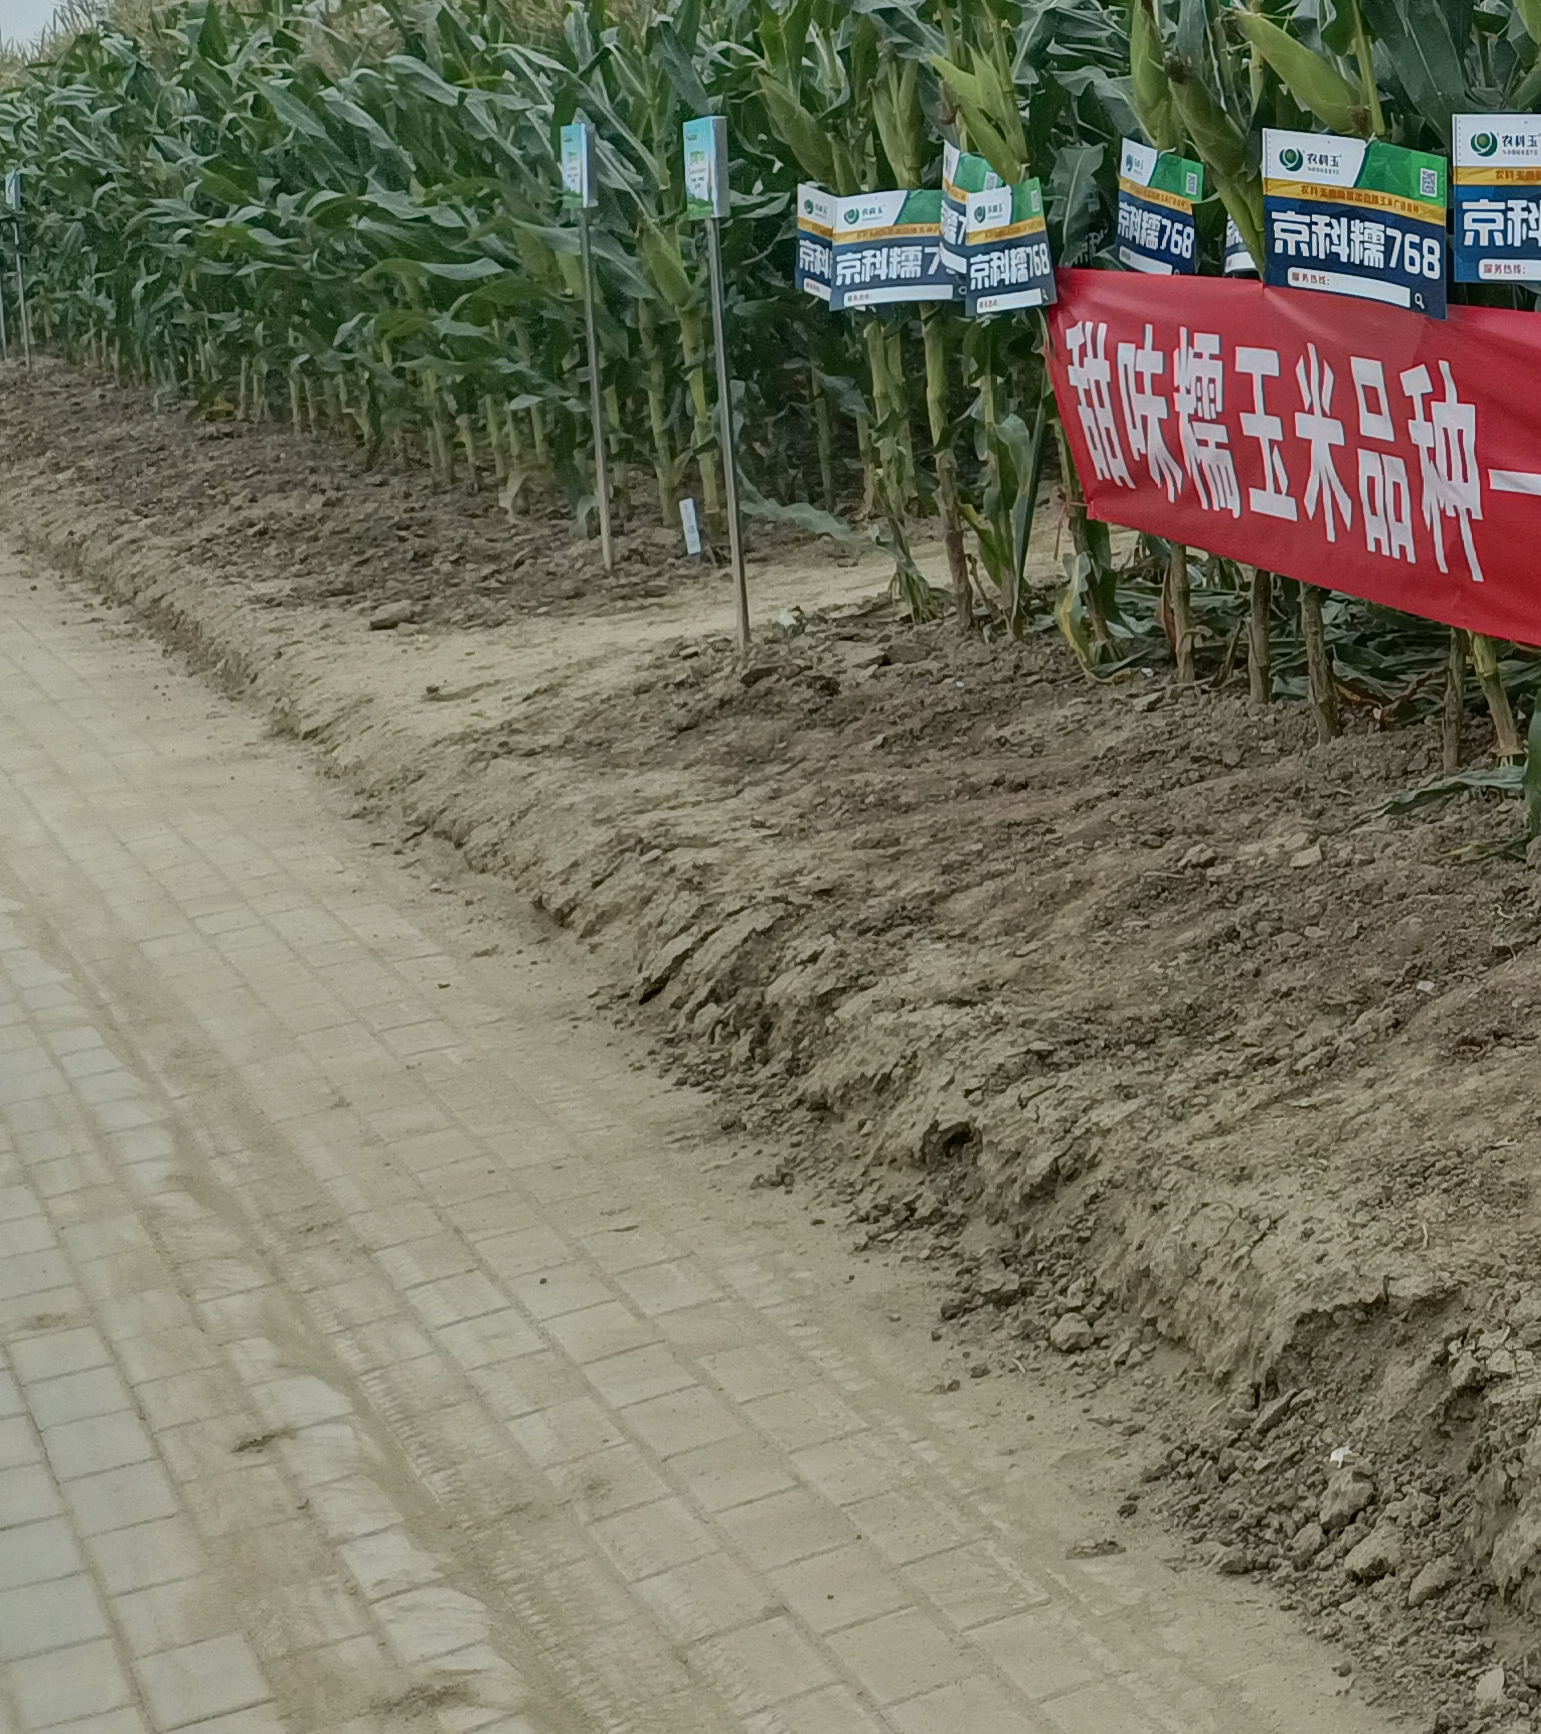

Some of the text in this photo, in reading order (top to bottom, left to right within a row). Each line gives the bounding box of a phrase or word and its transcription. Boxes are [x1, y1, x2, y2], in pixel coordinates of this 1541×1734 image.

[1118, 201, 1196, 259] 京科糯768
[1272, 210, 1441, 280] 京科糯768
[800, 239, 833, 280] 京科
[836, 246, 956, 287] 京科糯7
[969, 242, 1051, 290] 京科糯768
